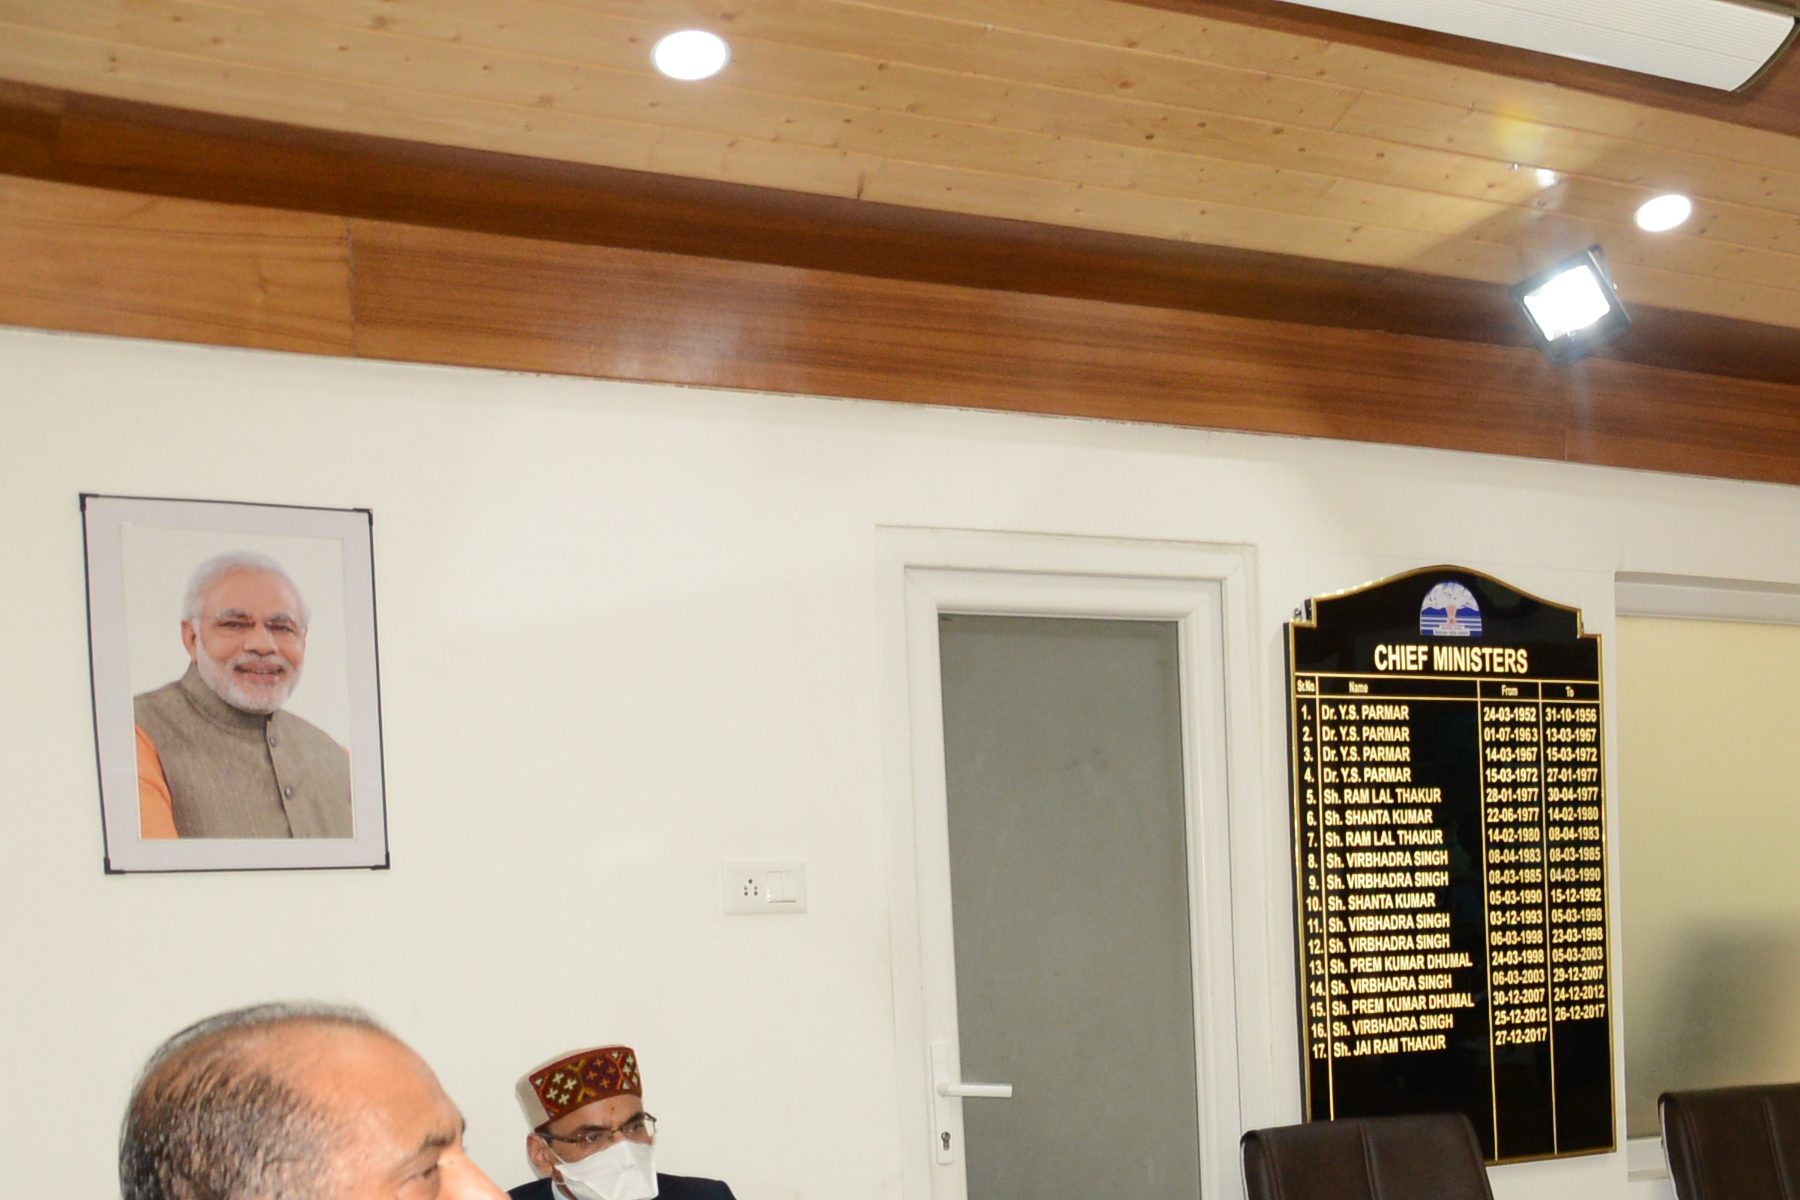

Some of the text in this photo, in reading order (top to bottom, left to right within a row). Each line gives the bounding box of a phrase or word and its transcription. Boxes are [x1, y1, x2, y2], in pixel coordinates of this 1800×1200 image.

[1374, 644, 1528, 674] CHIEF MINISTERS
[1349, 681, 1368, 693] Name
[1501, 684, 1518, 696] From
[1565, 686, 1574, 698] To
[1301, 704, 1311, 720] 1.
[1321, 704, 1409, 720] Dr. Y.S. PARMAR
[1483, 707, 1536, 722] 24-03-1952
[1545, 707, 1597, 722] 31-10-1956
[1302, 726, 1313, 741] 2.
[1322, 726, 1410, 741] Dr. Y.S. PARMAR
[1484, 727, 1538, 742] 01-07-1963
[1546, 728, 1597, 742] 13-03-1967
[1304, 747, 1313, 762] 3.
[1322, 746, 1411, 762] Dr. Y.S. PARMAR
[1485, 747, 1538, 762] 14-03-1967
[1546, 747, 1597, 762] 15-03-1972
[1304, 767, 1314, 782] 4.
[1323, 767, 1411, 783] Dr. Y.S. PARMAR
[1485, 768, 1538, 783] 15-03-1972
[1547, 768, 1598, 782] 27-01-1977
[1306, 789, 1316, 804] 5.
[1323, 788, 1441, 804] Sh. RAM LAL THAKUR
[1486, 787, 1539, 802] 28-01-1977
[1547, 787, 1598, 802] 30-04-1977
[1306, 811, 1317, 826] 6.
[1325, 809, 1433, 826] Sh. SHANTA KUMAR
[1487, 807, 1539, 822] 22-06-1977
[1548, 807, 1599, 821] 14-02-1980
[1307, 832, 1318, 848] 7.
[1325, 830, 1443, 847] Sh. RAM LAL THAKUR
[1487, 828, 1540, 842] 14-02-1980
[1548, 826, 1599, 841] 08-04-1983
[1308, 853, 1318, 869] 8.
[1326, 850, 1449, 869] Sh. VIRBHADRA SINGH
[1488, 848, 1541, 864] 08-04-1983
[1549, 847, 1601, 862] 08-03-1985
[1309, 875, 1319, 890] 9.
[1327, 871, 1449, 890] Sh. VIRBHADRA SINGH
[1489, 869, 1542, 885] 08-03-1985
[1550, 868, 1601, 882] 04-03-1990
[1328, 893, 1436, 911] Sh. SHANTA KUMAR
[1489, 889, 1542, 905] 05-03-1990
[1551, 888, 1601, 903] 15-12-1992
[1306, 897, 1322, 912] 10.
[1328, 913, 1450, 932] Sh. VIRBHADRA SINGH
[1490, 910, 1543, 925] 03-12-1993
[1551, 908, 1602, 923] 05-03-1998
[1307, 918, 1323, 933] 11.
[1491, 930, 1543, 946] 06-03-1998
[1552, 927, 1603, 943] 23-03-1998
[1308, 939, 1323, 954] 12.
[1329, 933, 1450, 953] Sh. VIRBHADRA SINGH
[1492, 949, 1544, 965] 24-03-1998
[1552, 946, 1603, 963] 05-03-2003
[1309, 960, 1324, 975] 13.
[1330, 952, 1473, 974] Sh. PREM KUMAR DHUMAL
[1493, 969, 1545, 986] 06-03-2003
[1553, 965, 1604, 982] 29-12-2007
[1310, 981, 1325, 996] 14.
[1331, 974, 1452, 995] Sh. VIRBHADRA SINGH
[1493, 988, 1545, 1006] 30-12-2007
[1554, 985, 1604, 1002] 24-12-2012
[1310, 1002, 1326, 1017] 15.
[1332, 993, 1475, 1016] Sh. PREM KUMAR DHUMAL
[1494, 1007, 1547, 1025] 25-12-2012
[1555, 1004, 1605, 1021] 26-12-2017
[1311, 1023, 1327, 1038] 16.
[1333, 1014, 1454, 1037] Sh. VIRBHADRA SINGH
[1495, 1027, 1547, 1045] 27-12-2017
[1312, 1043, 1327, 1059] 17.
[1333, 1035, 1446, 1058] Sh. JAI RAM THAKUR
